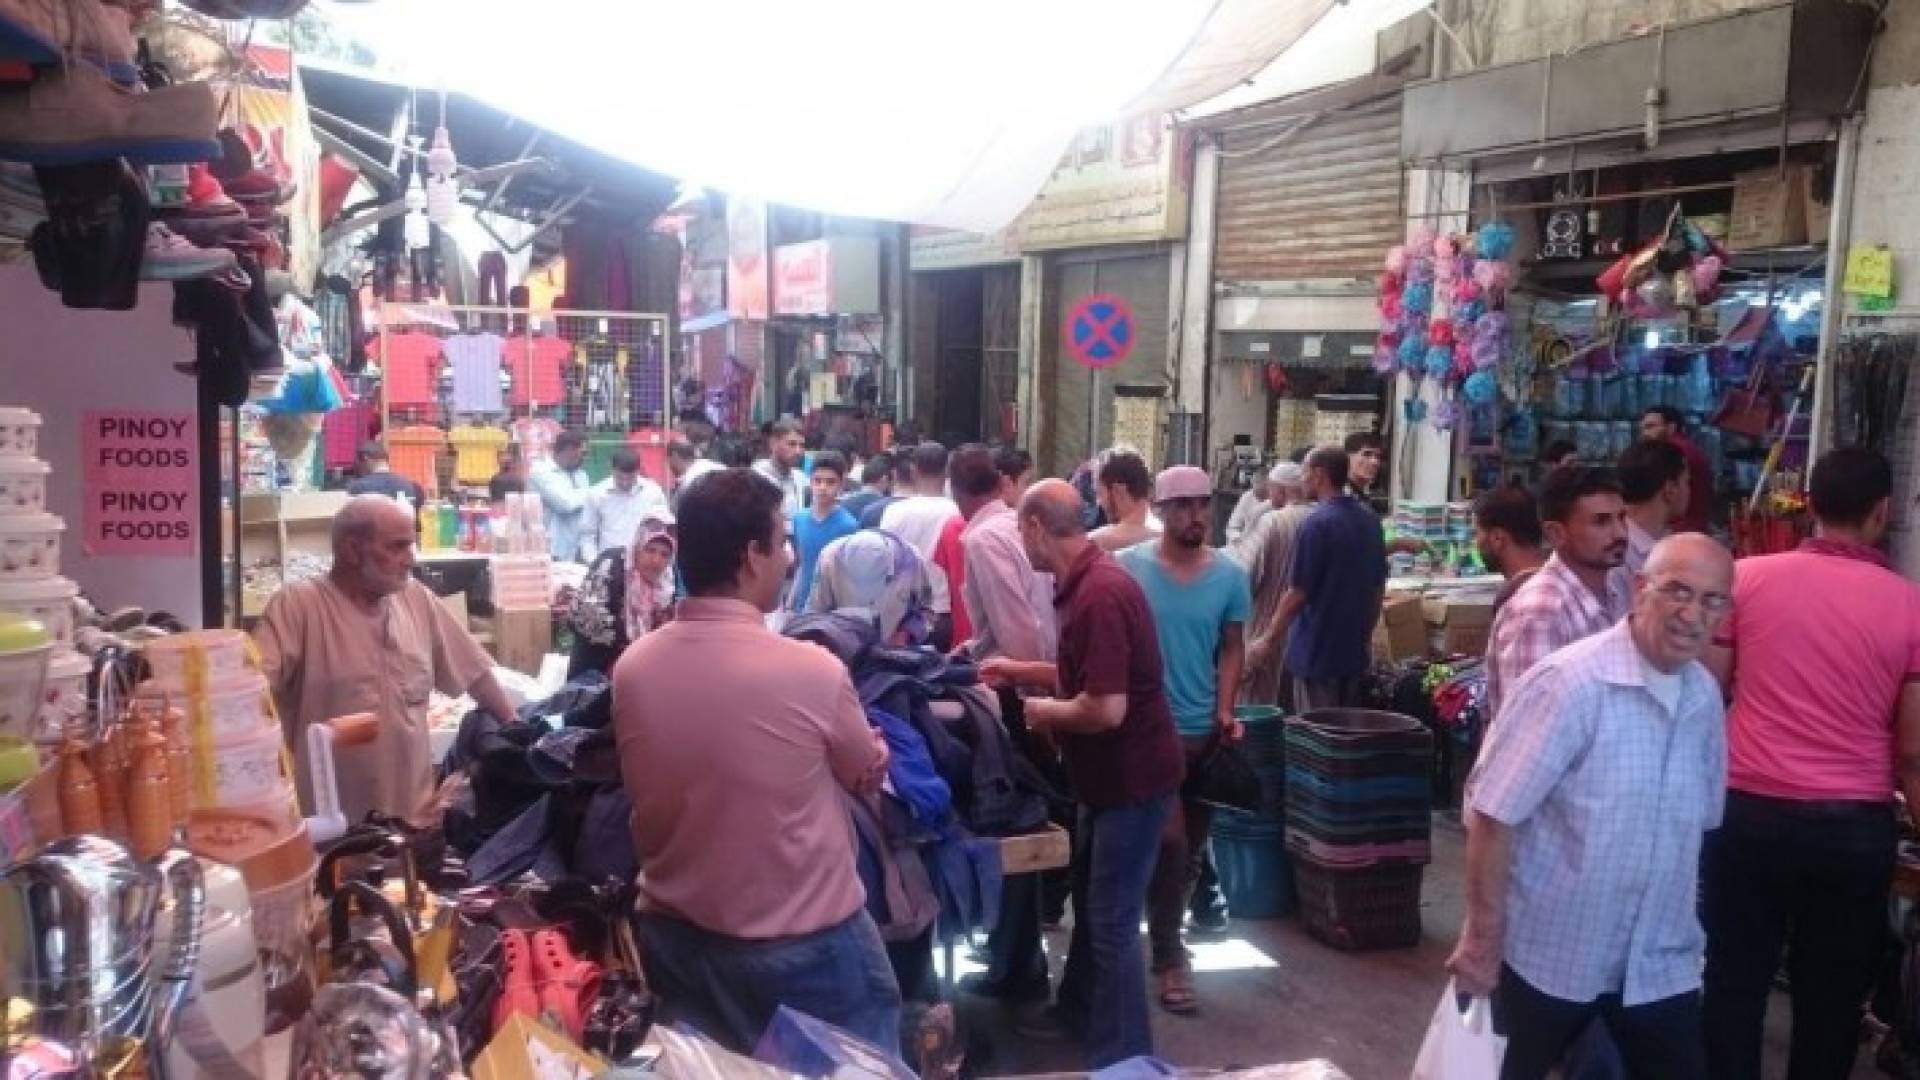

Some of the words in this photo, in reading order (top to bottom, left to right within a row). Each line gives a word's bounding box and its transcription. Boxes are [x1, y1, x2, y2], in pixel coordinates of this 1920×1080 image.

[100, 418, 187, 438] PINOY
[100, 448, 189, 467] FOODS
[101, 492, 187, 512] PINOY
[102, 521, 189, 540] FOODS
